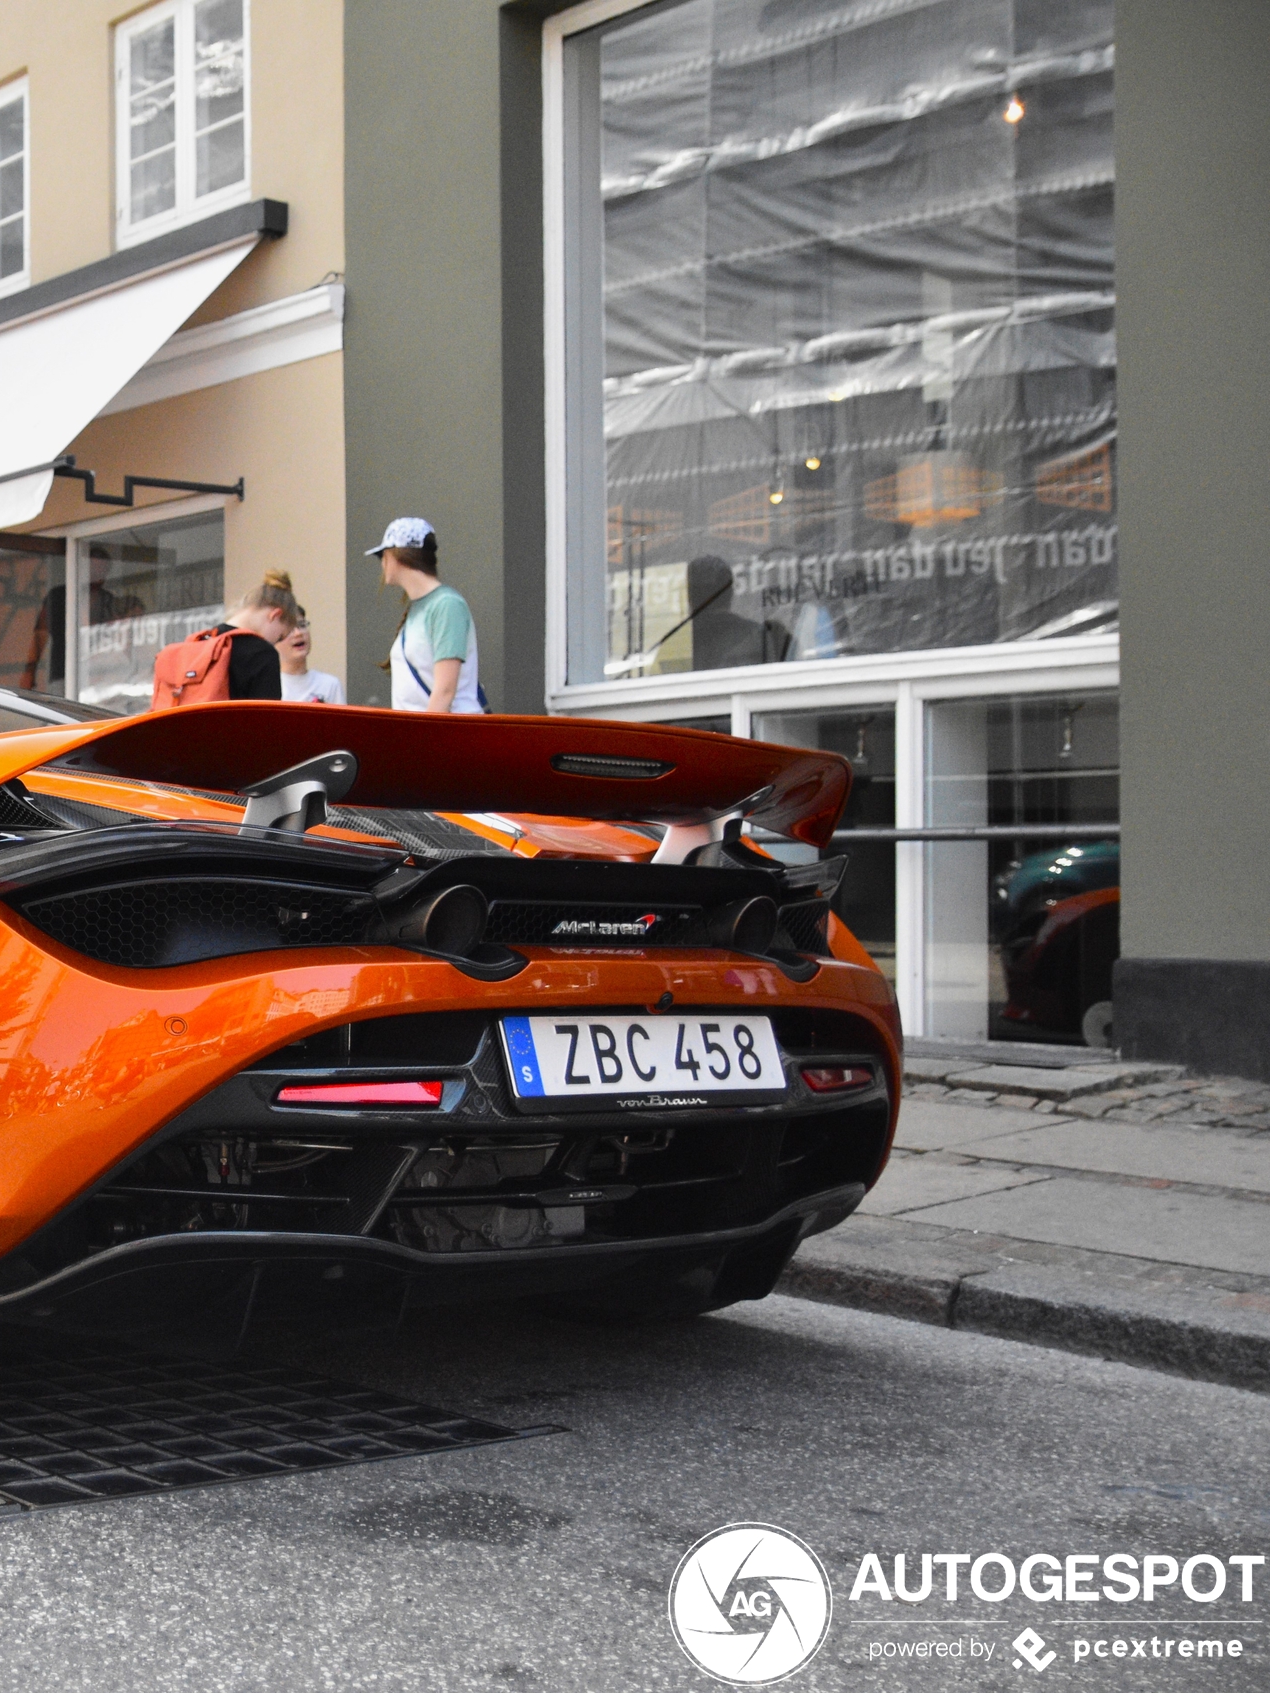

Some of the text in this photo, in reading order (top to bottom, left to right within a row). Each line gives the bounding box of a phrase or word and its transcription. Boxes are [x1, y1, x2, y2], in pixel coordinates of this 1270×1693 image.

[551, 918, 647, 936] McLaren
[554, 1021, 763, 1086] ZBC 458
[521, 1065, 534, 1083] S
